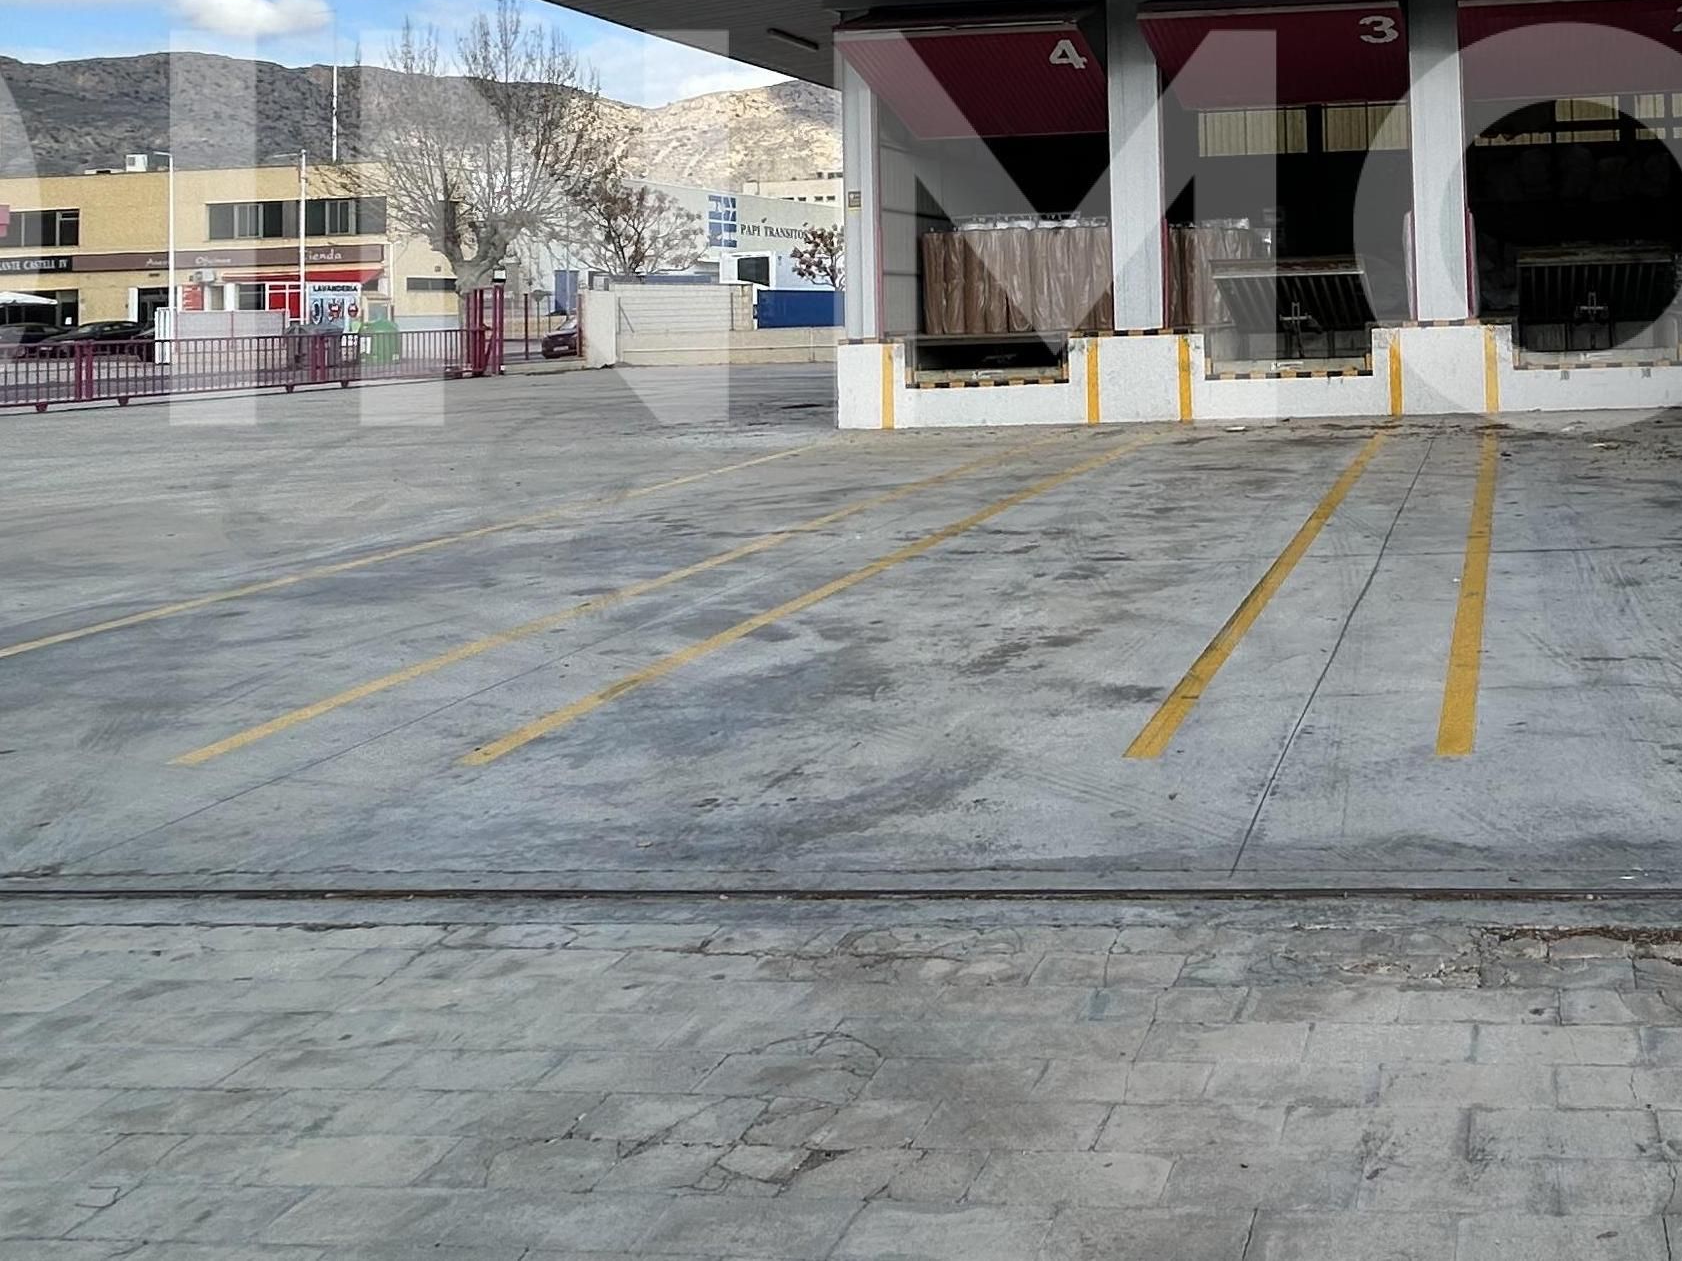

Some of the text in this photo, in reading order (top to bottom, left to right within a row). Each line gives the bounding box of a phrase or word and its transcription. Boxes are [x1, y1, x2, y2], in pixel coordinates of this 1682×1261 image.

[1359, 16, 1399, 43] 3
[1049, 39, 1087, 69] 4
[740, 223, 761, 237] PAPI
